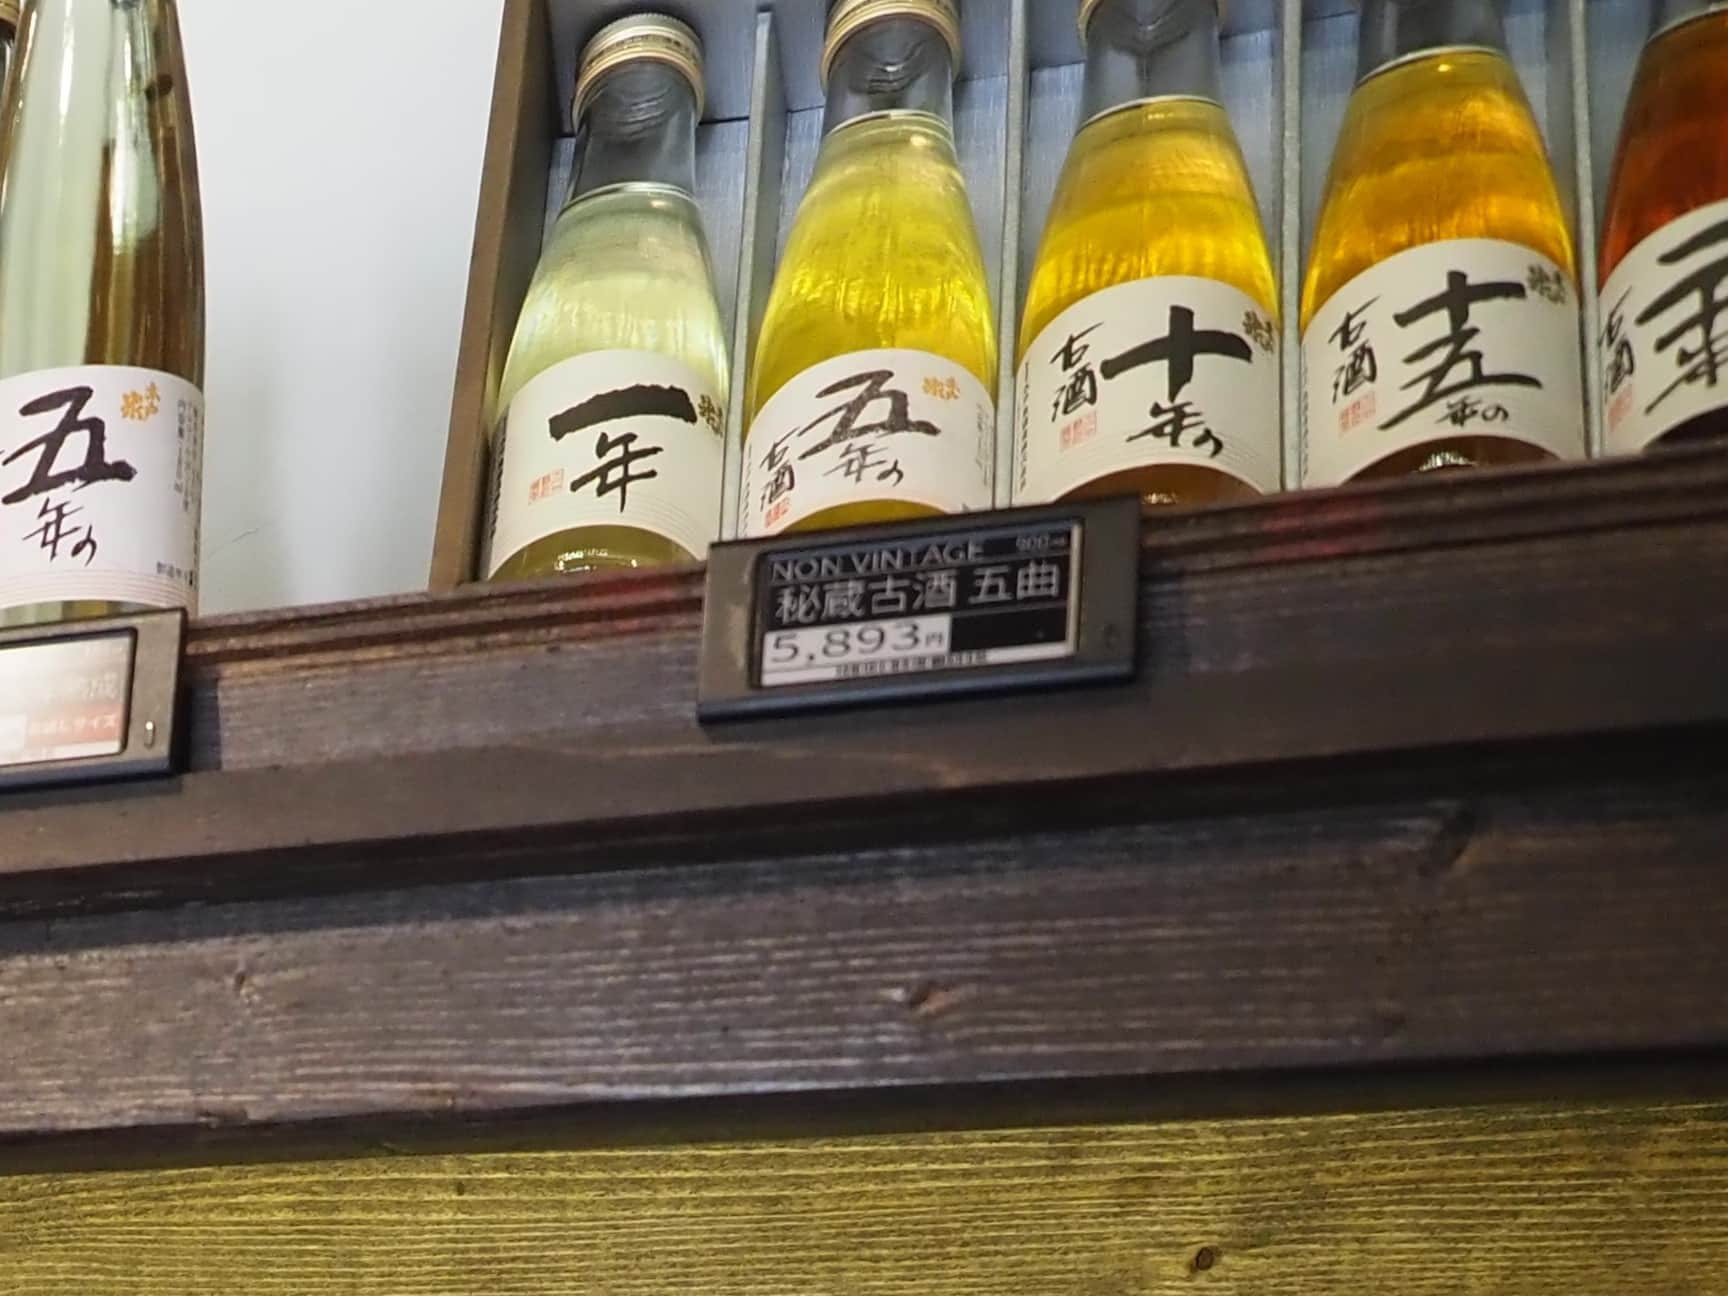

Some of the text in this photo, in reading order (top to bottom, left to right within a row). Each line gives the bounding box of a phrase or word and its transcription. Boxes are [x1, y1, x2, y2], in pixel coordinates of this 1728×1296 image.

[772, 540, 984, 581] NON VINTAGE
[775, 561, 1061, 625] 秘蔵古酒 五曲
